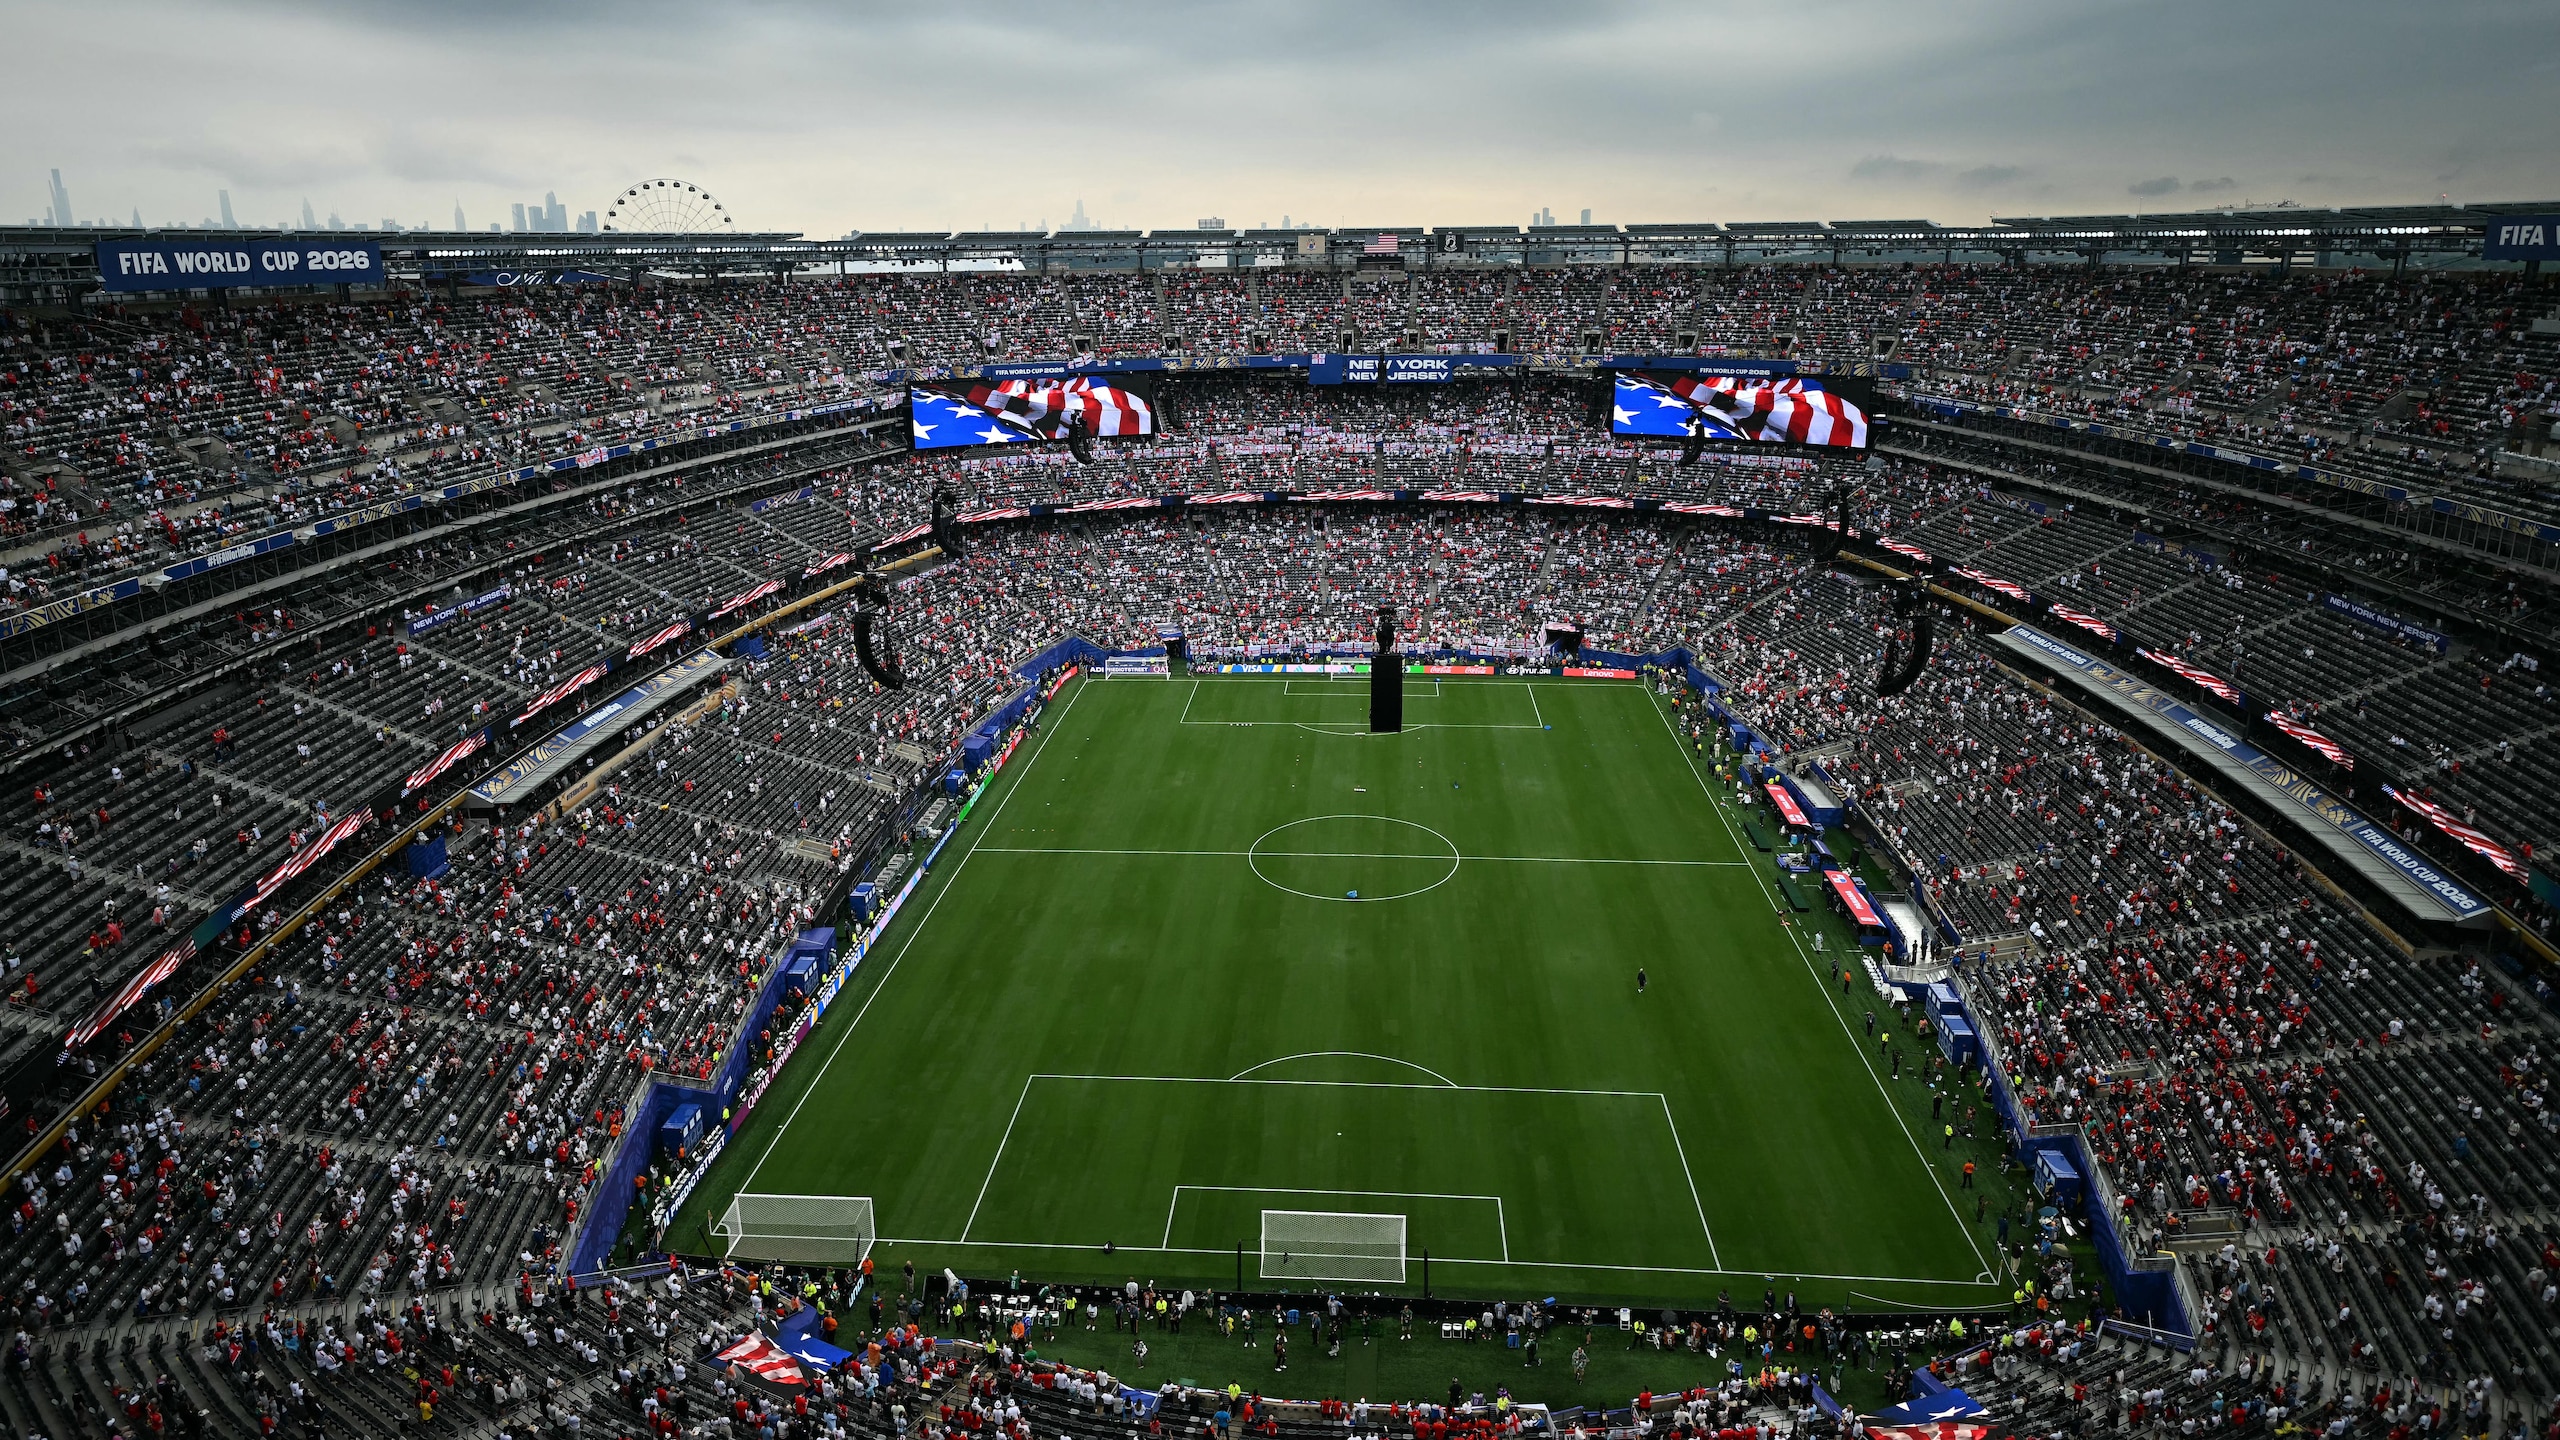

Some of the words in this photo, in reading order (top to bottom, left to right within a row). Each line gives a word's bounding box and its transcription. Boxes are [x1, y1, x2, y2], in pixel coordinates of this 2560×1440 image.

[2498, 225, 2545, 246] FIFA
[118, 252, 169, 275] FIFA
[173, 252, 251, 274] WORLD
[261, 251, 299, 271] CUP
[306, 250, 370, 271] 2026
[1009, 368, 1031, 376] WORLD
[1349, 359, 1393, 370] NEW
[1396, 359, 1449, 370] YORK
[1387, 371, 1449, 381] JERSEY
[207, 544, 256, 567] #FIFAWorldCup
[412, 617, 433, 630] NEW
[434, 608, 457, 621] YORK
[2329, 596, 2351, 610] NEW
[2351, 604, 2376, 621] YORK
[2376, 614, 2399, 628] NEW
[2399, 624, 2441, 644] JERSEY
[2015, 628, 2032, 638] FIFA
[2028, 634, 2052, 648] WORLD
[2049, 644, 2065, 654] CUP
[2060, 651, 2087, 665] 2026
[1242, 664, 1263, 673] VISA
[1583, 669, 1615, 678] Lenovo
[2359, 828, 2385, 846] FIFA
[2379, 841, 2419, 869] WORLD
[2412, 866, 2440, 882] CUP
[2431, 880, 2478, 910] 2026
[844, 950, 863, 973] VISA
[820, 984, 837, 1010] VISA
[747, 1073, 771, 1110] QATAR
[771, 1036, 798, 1079] AIRWAYS
[670, 1133, 727, 1218] PREDICTSTREET
